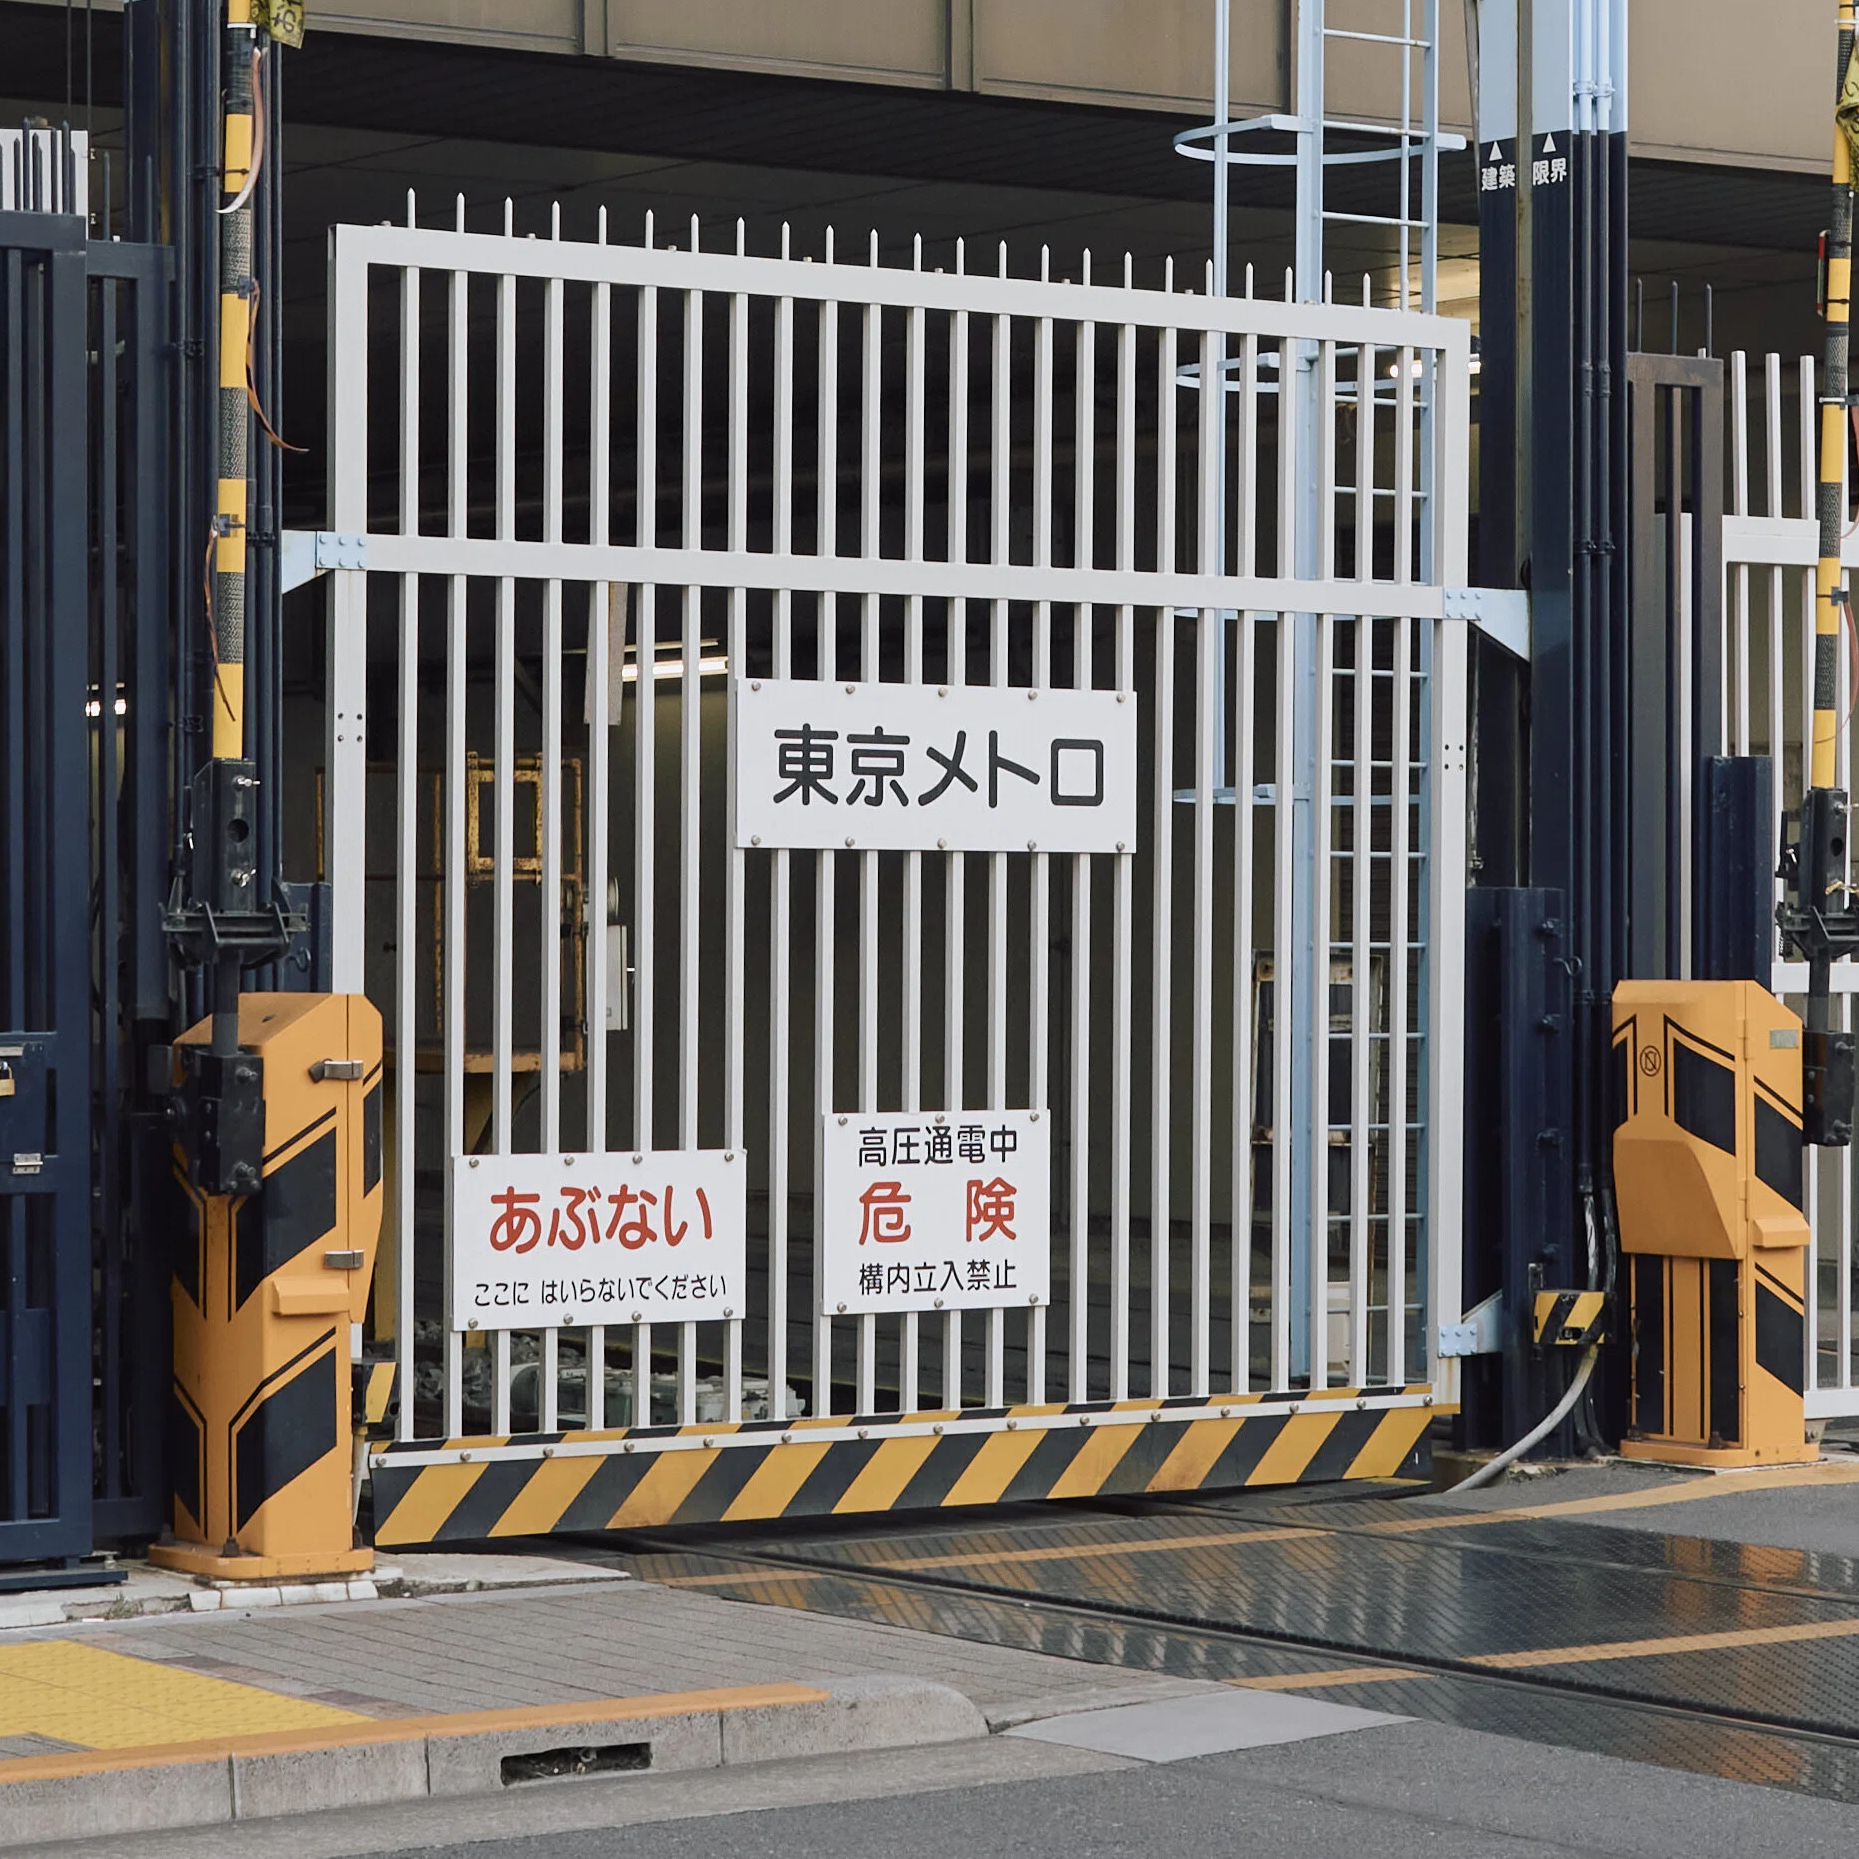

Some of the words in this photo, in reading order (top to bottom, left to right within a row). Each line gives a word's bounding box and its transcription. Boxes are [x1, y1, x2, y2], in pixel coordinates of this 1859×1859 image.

[1481, 163, 1516, 191] 建築
[1532, 157, 1567, 185] 限界
[773, 723, 1104, 808] 東京メトロ
[858, 1124, 1017, 1167] 高圧通電中
[489, 1183, 713, 1254] あぶない
[858, 1176, 1017, 1245] 危険
[474, 1280, 530, 1307] ここに
[541, 1273, 727, 1305] はいらないでください
[858, 1259, 1017, 1295] 構内立入禁止
